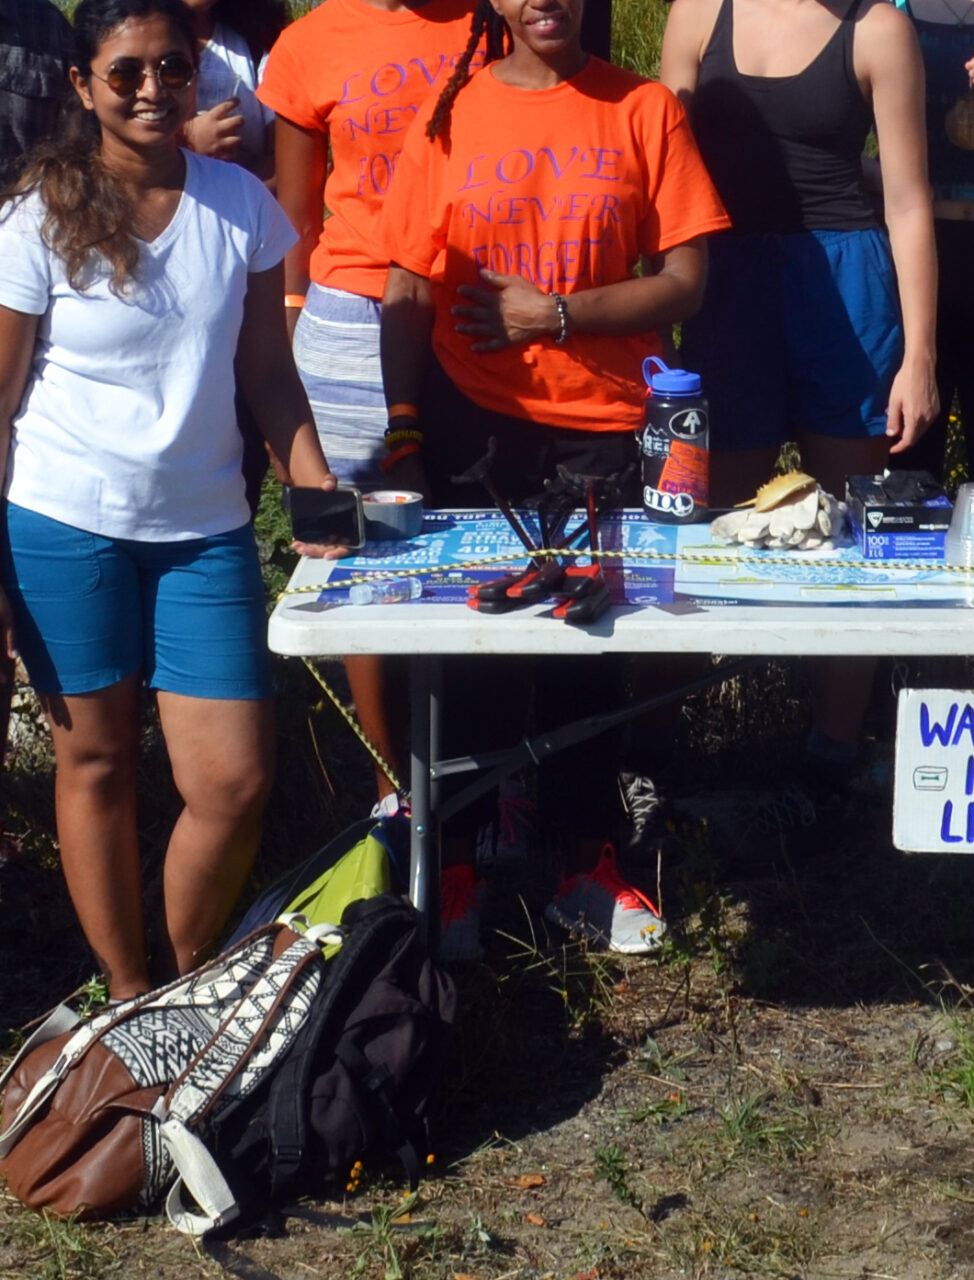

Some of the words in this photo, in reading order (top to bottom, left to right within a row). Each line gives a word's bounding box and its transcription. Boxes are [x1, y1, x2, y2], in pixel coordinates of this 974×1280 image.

[457, 145, 623, 192] LOVE
[462, 190, 621, 228] NEVER
[472, 237, 613, 292] FORGET
